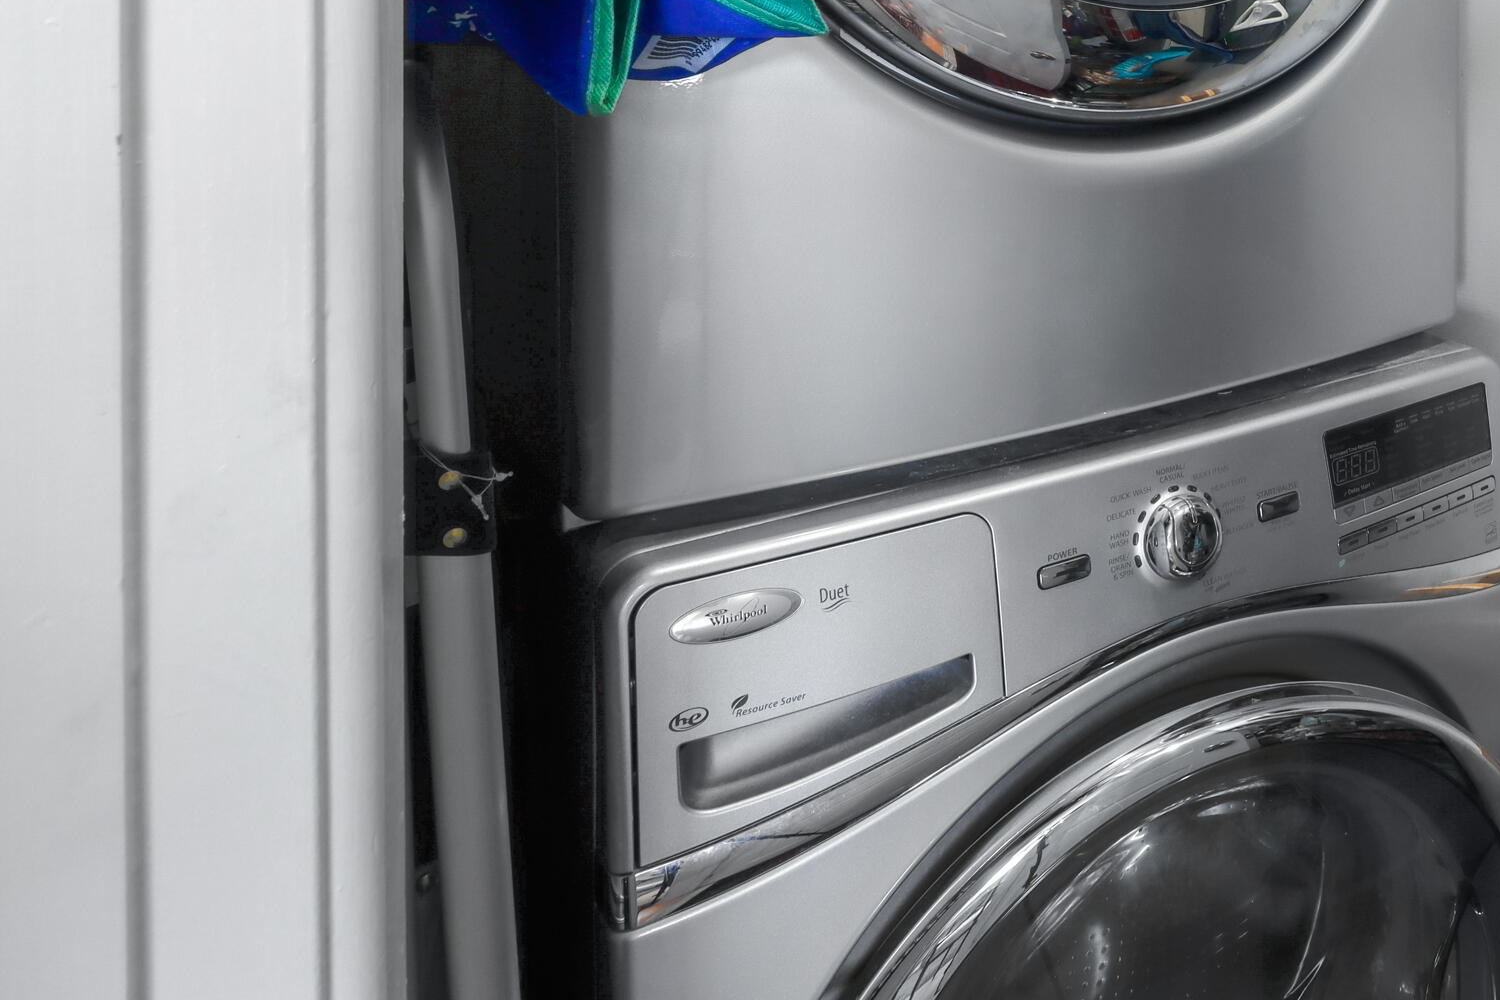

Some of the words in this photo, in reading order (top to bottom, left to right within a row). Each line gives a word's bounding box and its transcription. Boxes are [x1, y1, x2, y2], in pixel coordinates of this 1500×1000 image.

[1110, 491, 1131, 503] QUICK
[1132, 487, 1152, 498] WASH
[1106, 508, 1136, 522] DELICATE
[1110, 530, 1130, 541] HAND
[1109, 538, 1130, 550] WASH
[1047, 547, 1078, 562] POWER
[819, 584, 850, 603] Duet
[709, 604, 767, 627] Whirlpool
[735, 700, 779, 718] Resource
[781, 692, 807, 706] Saver
